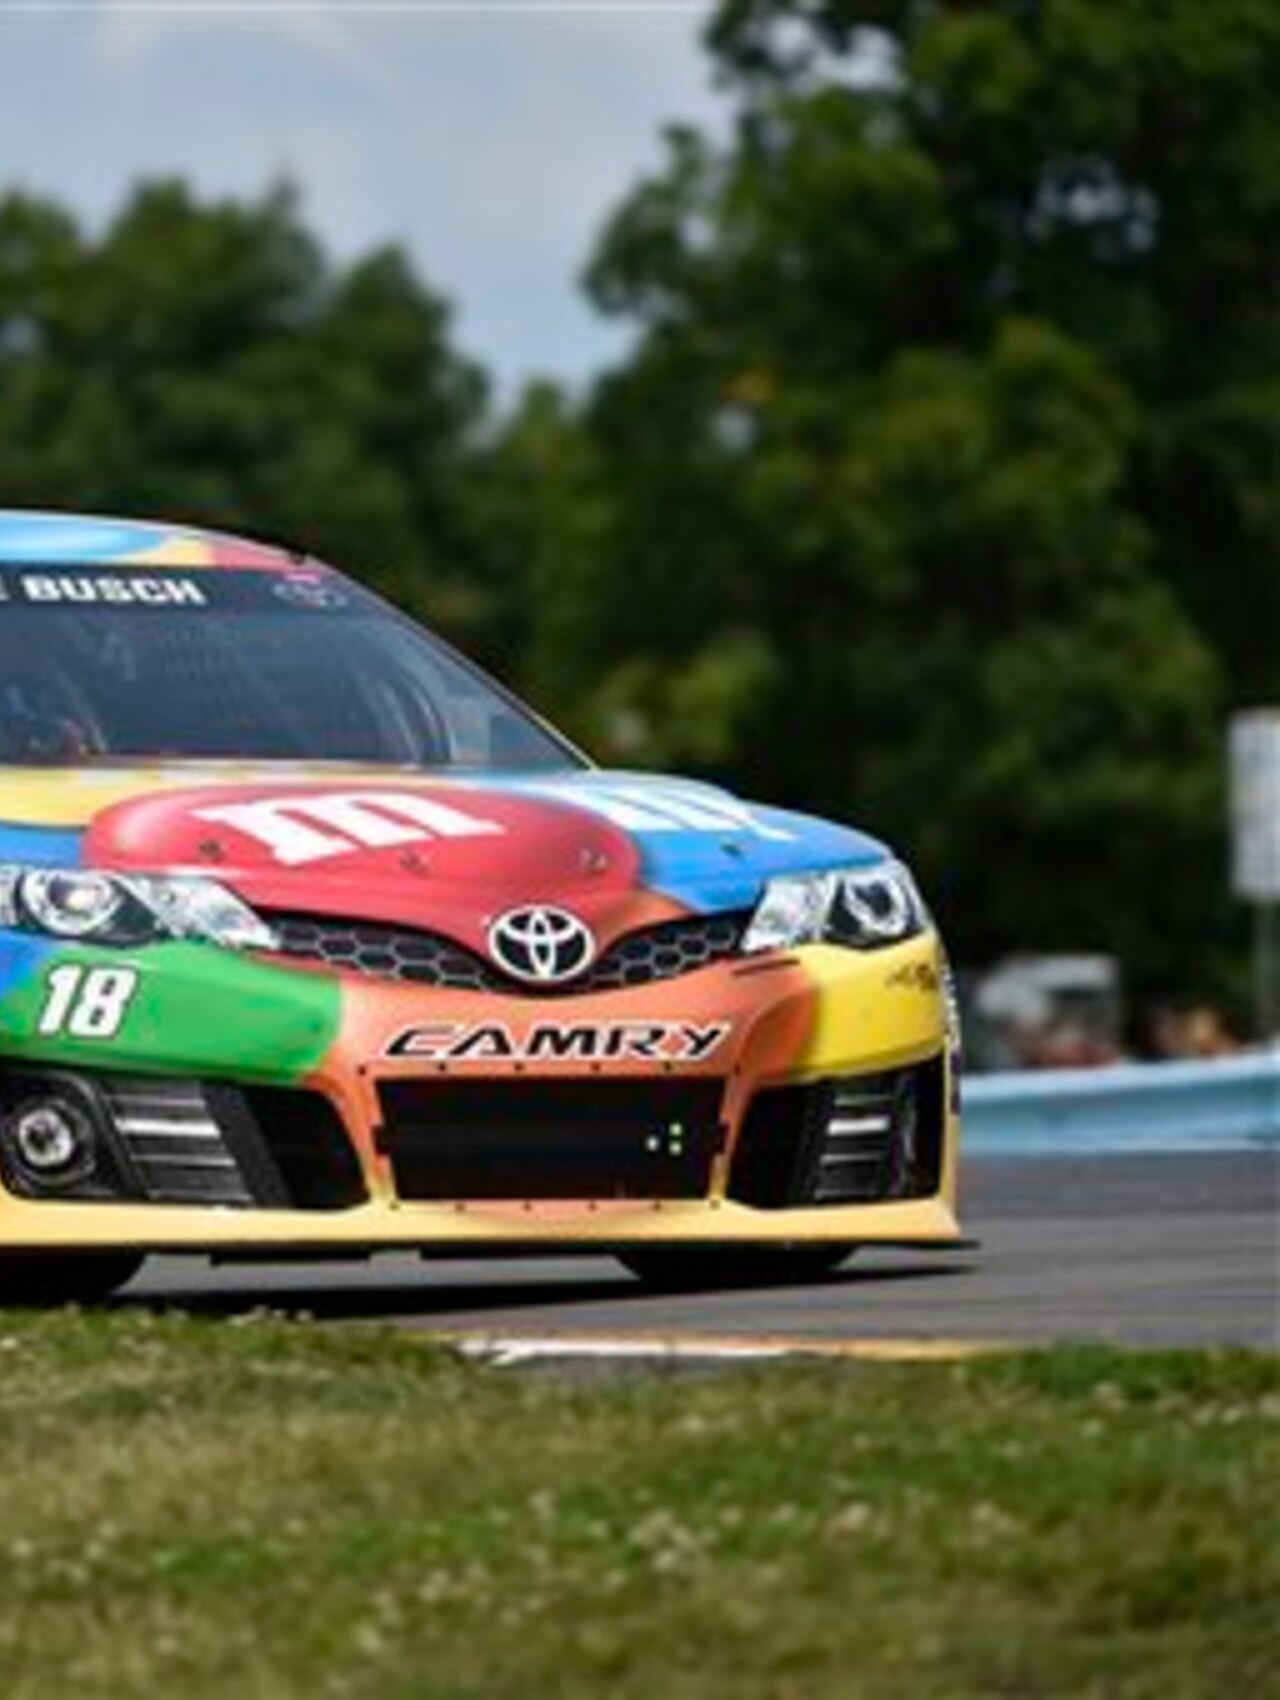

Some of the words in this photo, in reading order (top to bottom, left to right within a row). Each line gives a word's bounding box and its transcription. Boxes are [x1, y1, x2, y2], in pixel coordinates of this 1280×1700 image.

[20, 573, 207, 606] BUSCH
[37, 962, 140, 1038] 18
[381, 1021, 729, 1060] CAMRY
